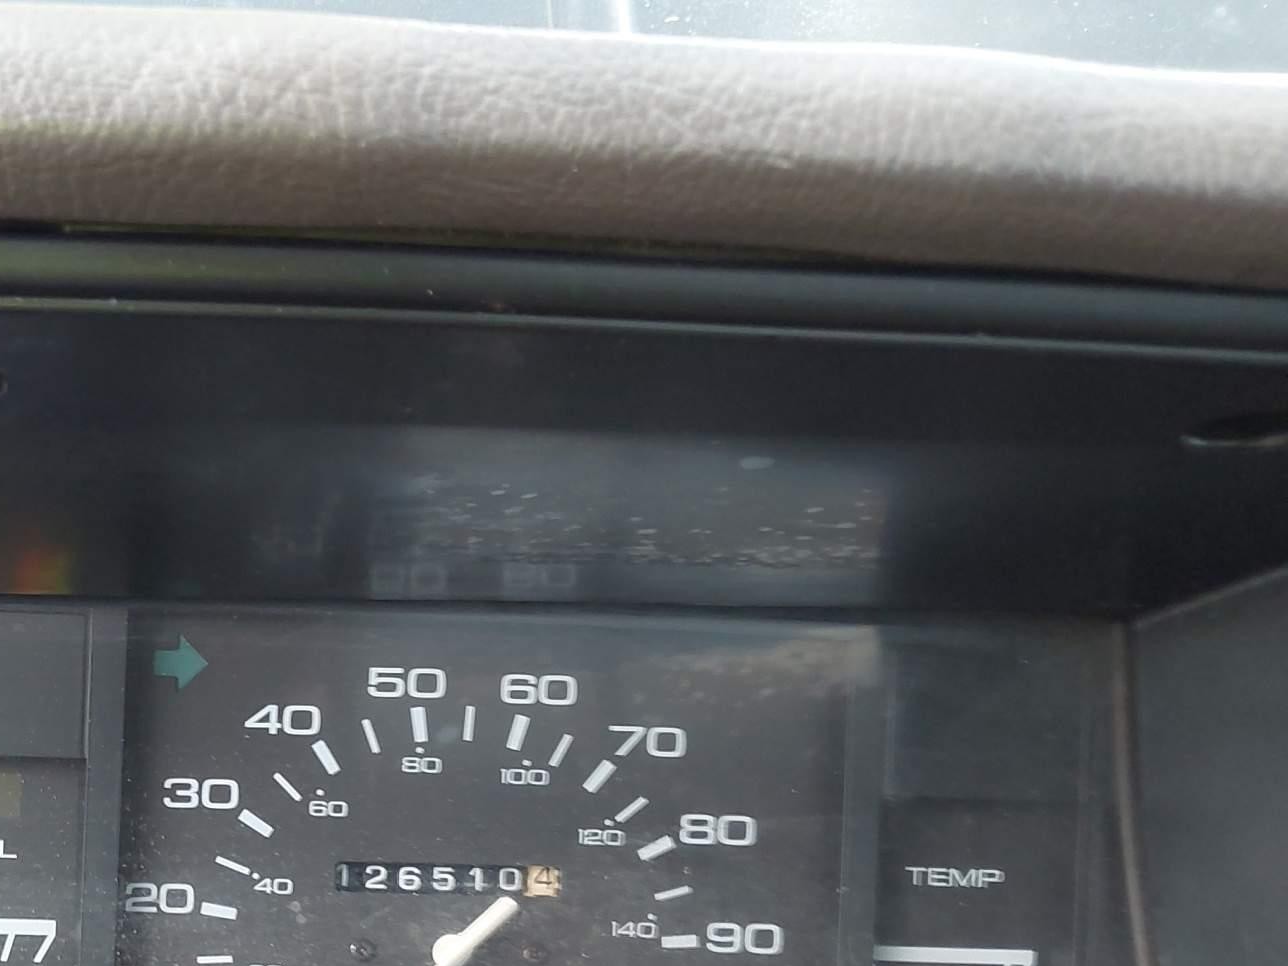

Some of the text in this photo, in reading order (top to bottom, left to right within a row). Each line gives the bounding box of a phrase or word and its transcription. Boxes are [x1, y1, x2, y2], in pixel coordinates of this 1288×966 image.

[366, 666, 447, 699] 50
[499, 674, 578, 706] 60
[244, 704, 322, 736] 40
[608, 724, 687, 758] 70
[401, 757, 443, 774] 80
[500, 768, 550, 786] 100
[162, 778, 240, 810] 30
[308, 800, 349, 818] 60
[577, 828, 626, 846] 120
[679, 814, 757, 846] 80
[253, 878, 294, 895] 40
[905, 866, 1006, 888] TEMP
[125, 882, 195, 914] 20
[611, 920, 658, 939] 140
[706, 922, 785, 956] 90
